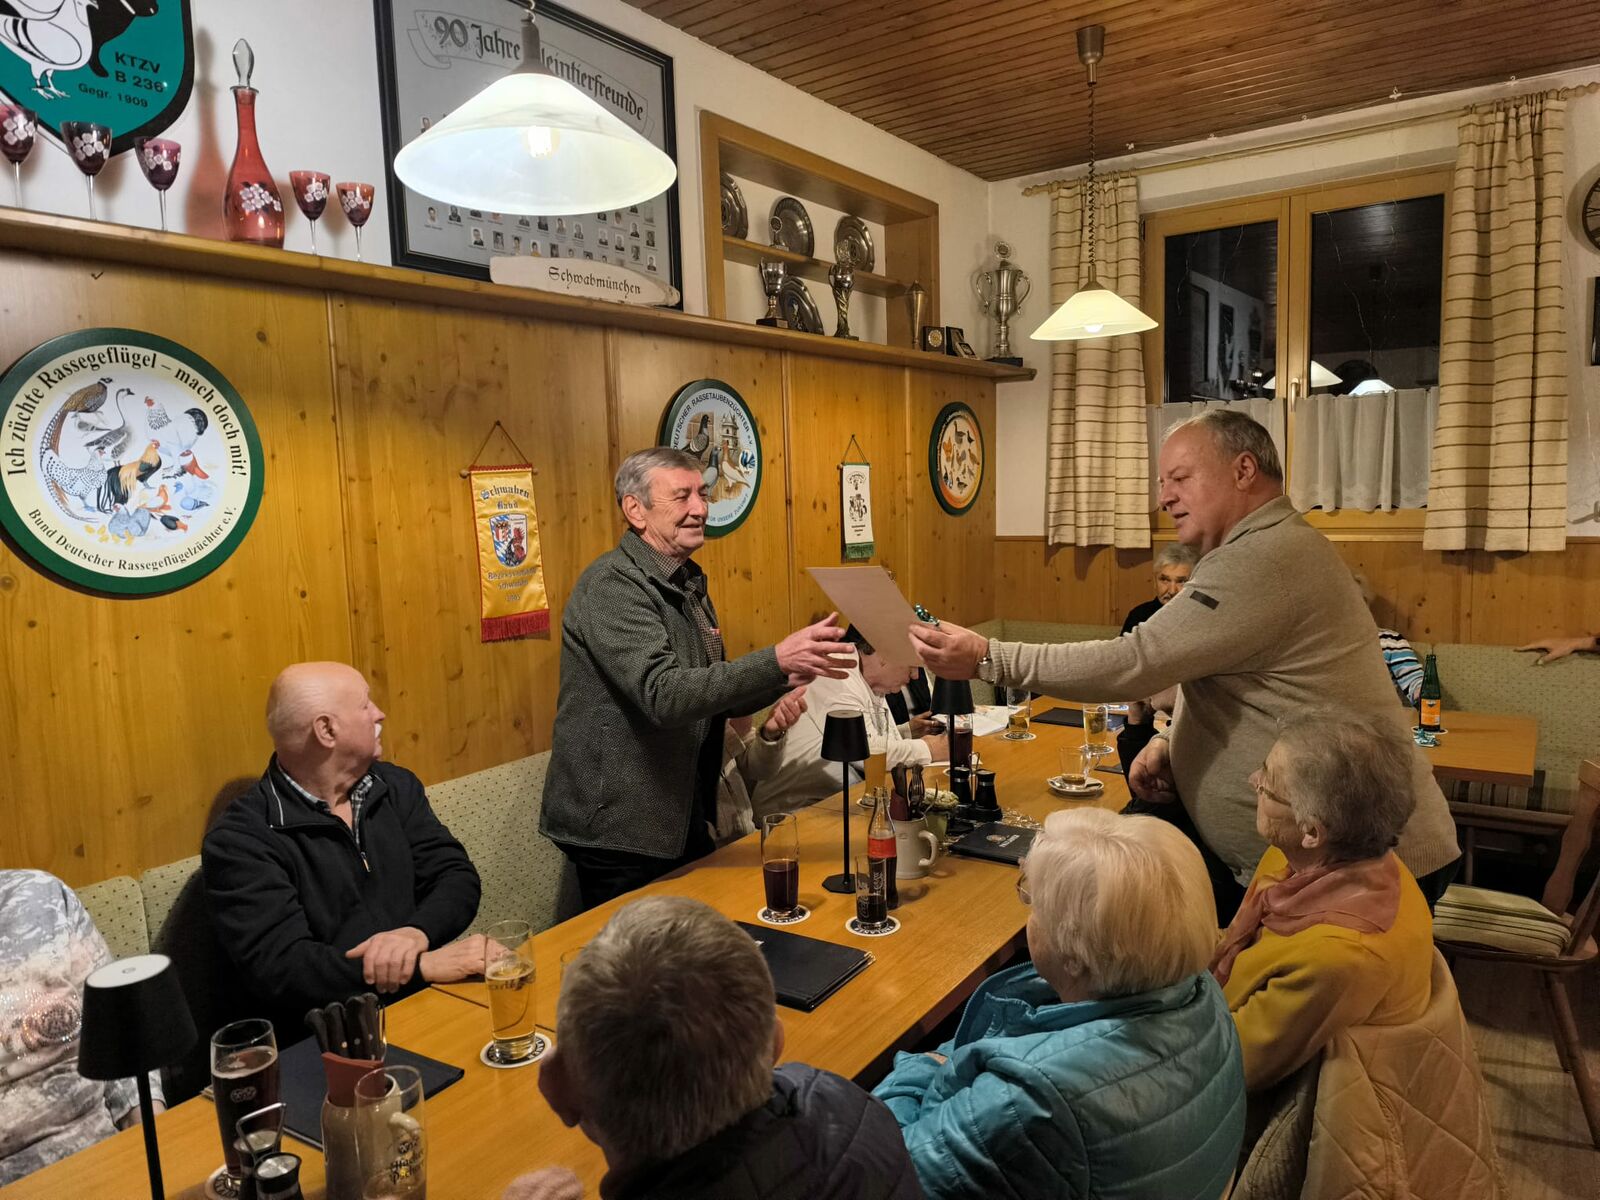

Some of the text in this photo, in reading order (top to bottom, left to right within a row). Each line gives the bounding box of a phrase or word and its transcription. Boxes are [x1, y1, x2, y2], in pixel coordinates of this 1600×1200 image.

[114, 51, 160, 74] KTZV
[433, 16, 644, 121] 90 Jahre leintierfreunde
[78, 82, 148, 108] Gegr. 1909
[115, 70, 164, 93] B 236
[548, 266, 642, 299] Schwabmünchen
[37, 345, 158, 391] Rassegeflügel
[174, 368, 215, 404] mach
[8, 387, 46, 444] züchte
[212, 402, 241, 440] doch
[7, 449, 28, 477] Ich
[229, 443, 248, 477] mit!
[28, 508, 59, 539] Bund
[55, 533, 115, 570] Deutscher
[117, 524, 225, 573] Rassegeflügelzüchter
